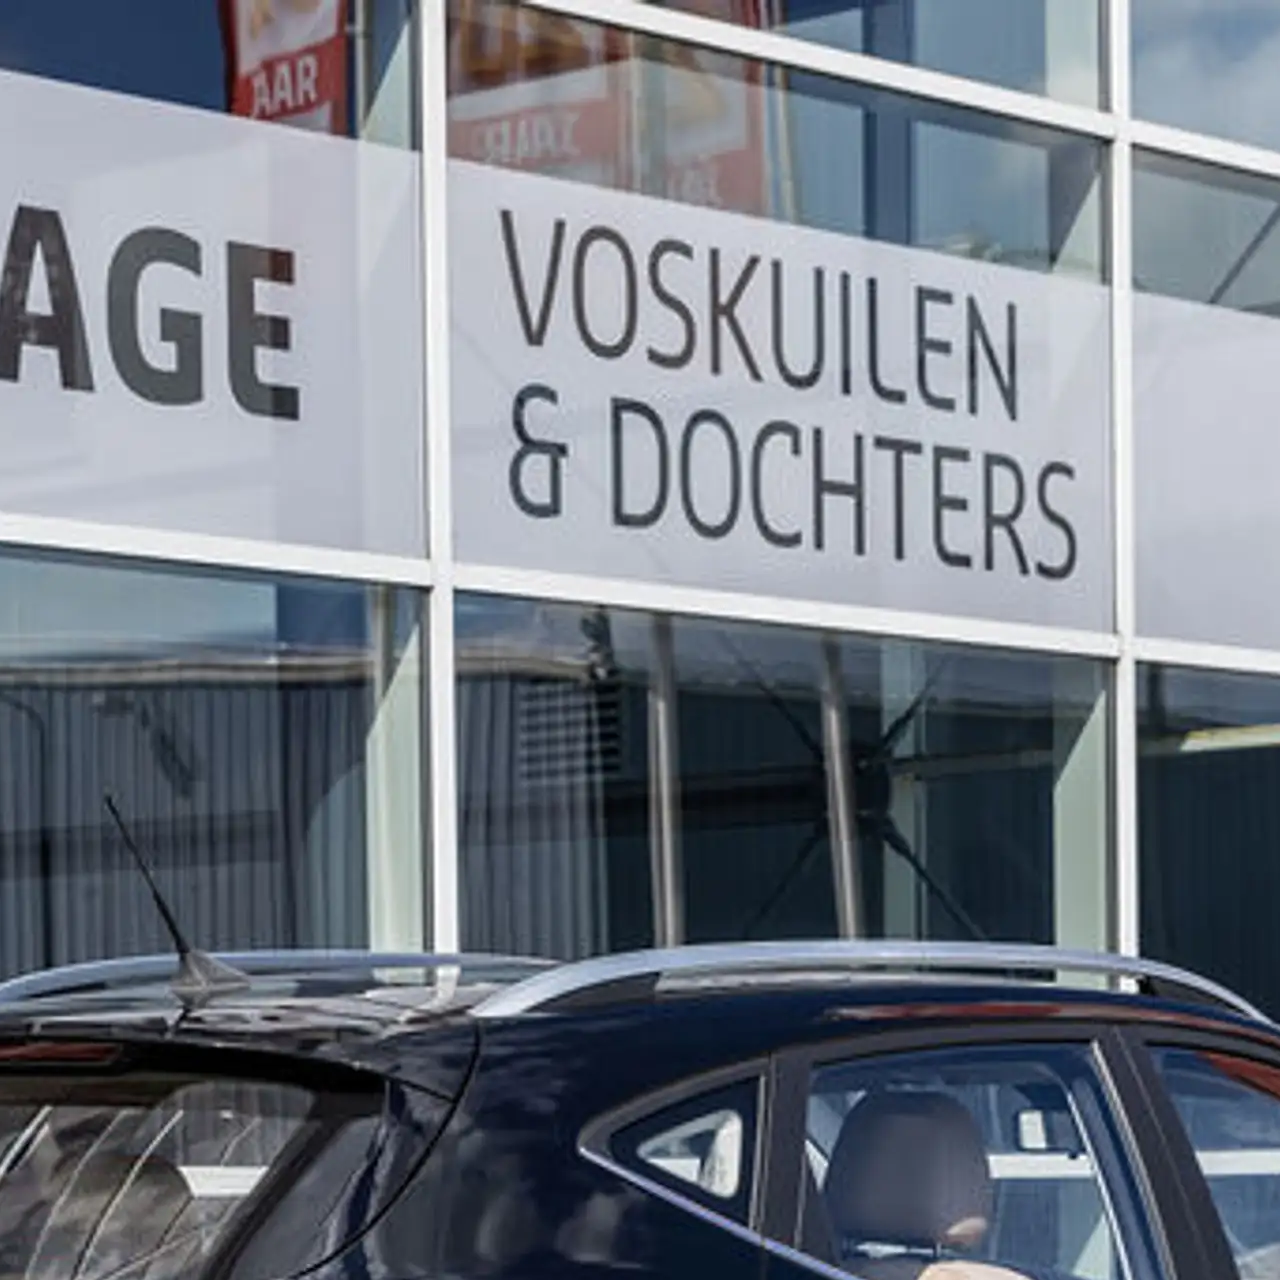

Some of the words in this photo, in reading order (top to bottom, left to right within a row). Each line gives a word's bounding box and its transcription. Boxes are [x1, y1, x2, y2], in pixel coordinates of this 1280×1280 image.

[500, 209, 1018, 422] VOSKUILEN
[508, 384, 568, 520] &
[610, 397, 1078, 581] DOCHTERS
